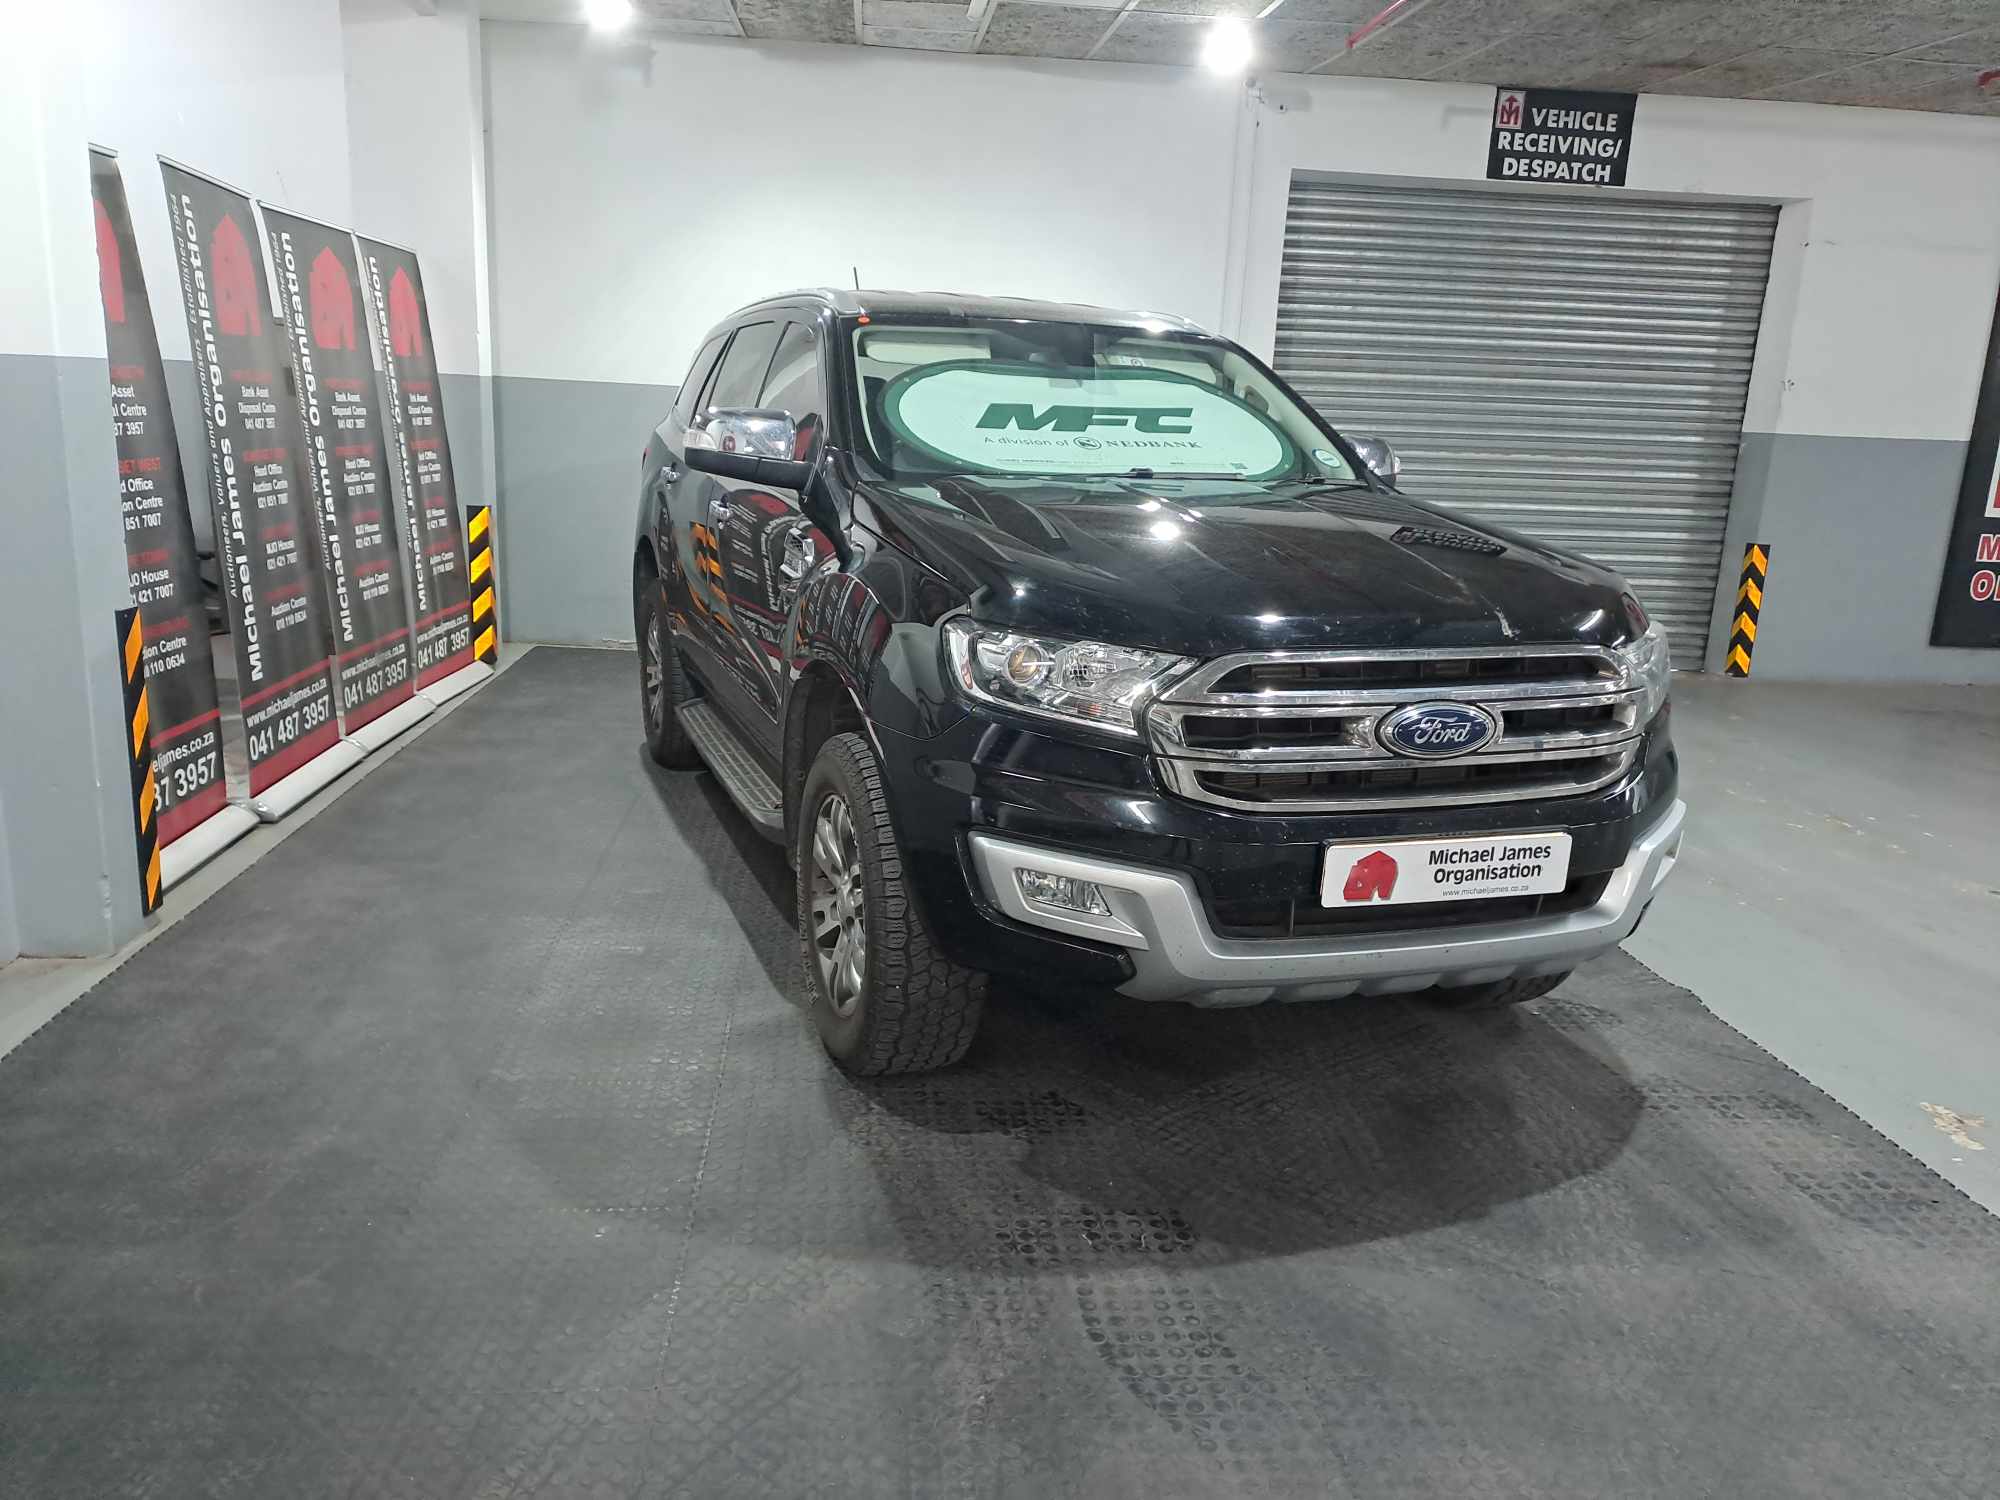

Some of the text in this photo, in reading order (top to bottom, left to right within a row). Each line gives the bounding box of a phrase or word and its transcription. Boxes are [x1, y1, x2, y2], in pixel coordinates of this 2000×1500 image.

[1532, 108, 1618, 132] VEHICLE
[1497, 131, 1623, 159] RECEIVING/
[1502, 157, 1611, 183] DESPATCH
[177, 236, 197, 324] Established
[112, 384, 135, 398] Asset
[194, 339, 212, 416] Appraisers
[120, 403, 147, 416] Centre
[976, 403, 1194, 434] MFC
[125, 421, 144, 435] 3957
[181, 194, 264, 682] Michael James Organisation
[206, 420, 217, 448] and
[281, 232, 354, 643] Michael James Organisation
[998, 436, 1052, 446] division
[1055, 438, 1070, 447] of
[1105, 440, 1203, 449] NEDBANK
[128, 478, 154, 492] Office
[212, 453, 225, 505] Valuers
[135, 496, 163, 510] Centre
[142, 513, 161, 528] 7007
[221, 512, 238, 598] Auctioneers,
[409, 518, 427, 611] Michael
[140, 569, 169, 584] House
[154, 583, 173, 599] 7007
[160, 637, 187, 653] Centre
[418, 626, 469, 669] 041 487 3957
[166, 652, 185, 670] 0634
[344, 657, 407, 708] 041 487 3957
[249, 694, 329, 761] 041 487 3957
[1412, 716, 1472, 744] Ford
[174, 751, 216, 797] 3957
[1428, 845, 1552, 866] Michael James
[1433, 863, 1542, 885] Organisation
